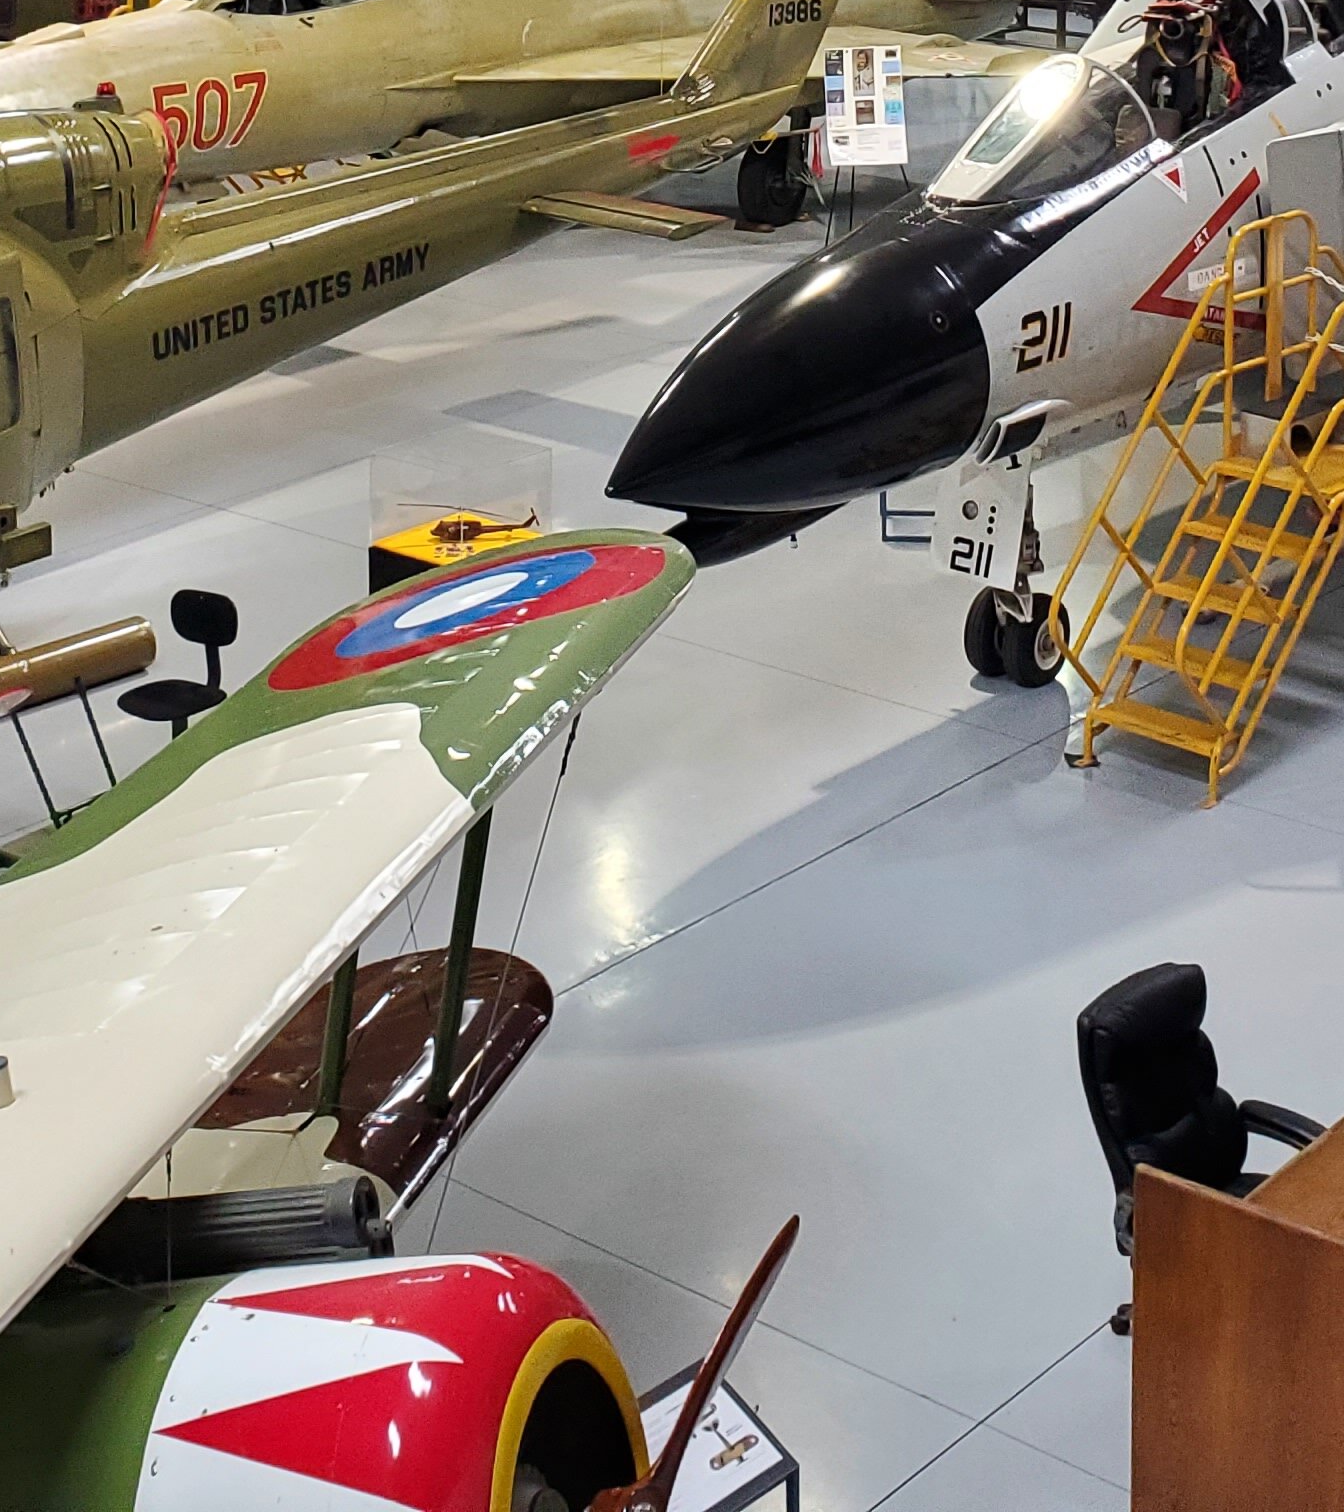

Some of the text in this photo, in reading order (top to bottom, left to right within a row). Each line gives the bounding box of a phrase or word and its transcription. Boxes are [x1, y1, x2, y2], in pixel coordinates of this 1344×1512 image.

[151, 69, 269, 153] 507
[1193, 227, 1211, 253] JET
[152, 242, 430, 360] UNITED STATES ARMY
[1015, 301, 1072, 374] 211
[949, 536, 994, 579] 211
